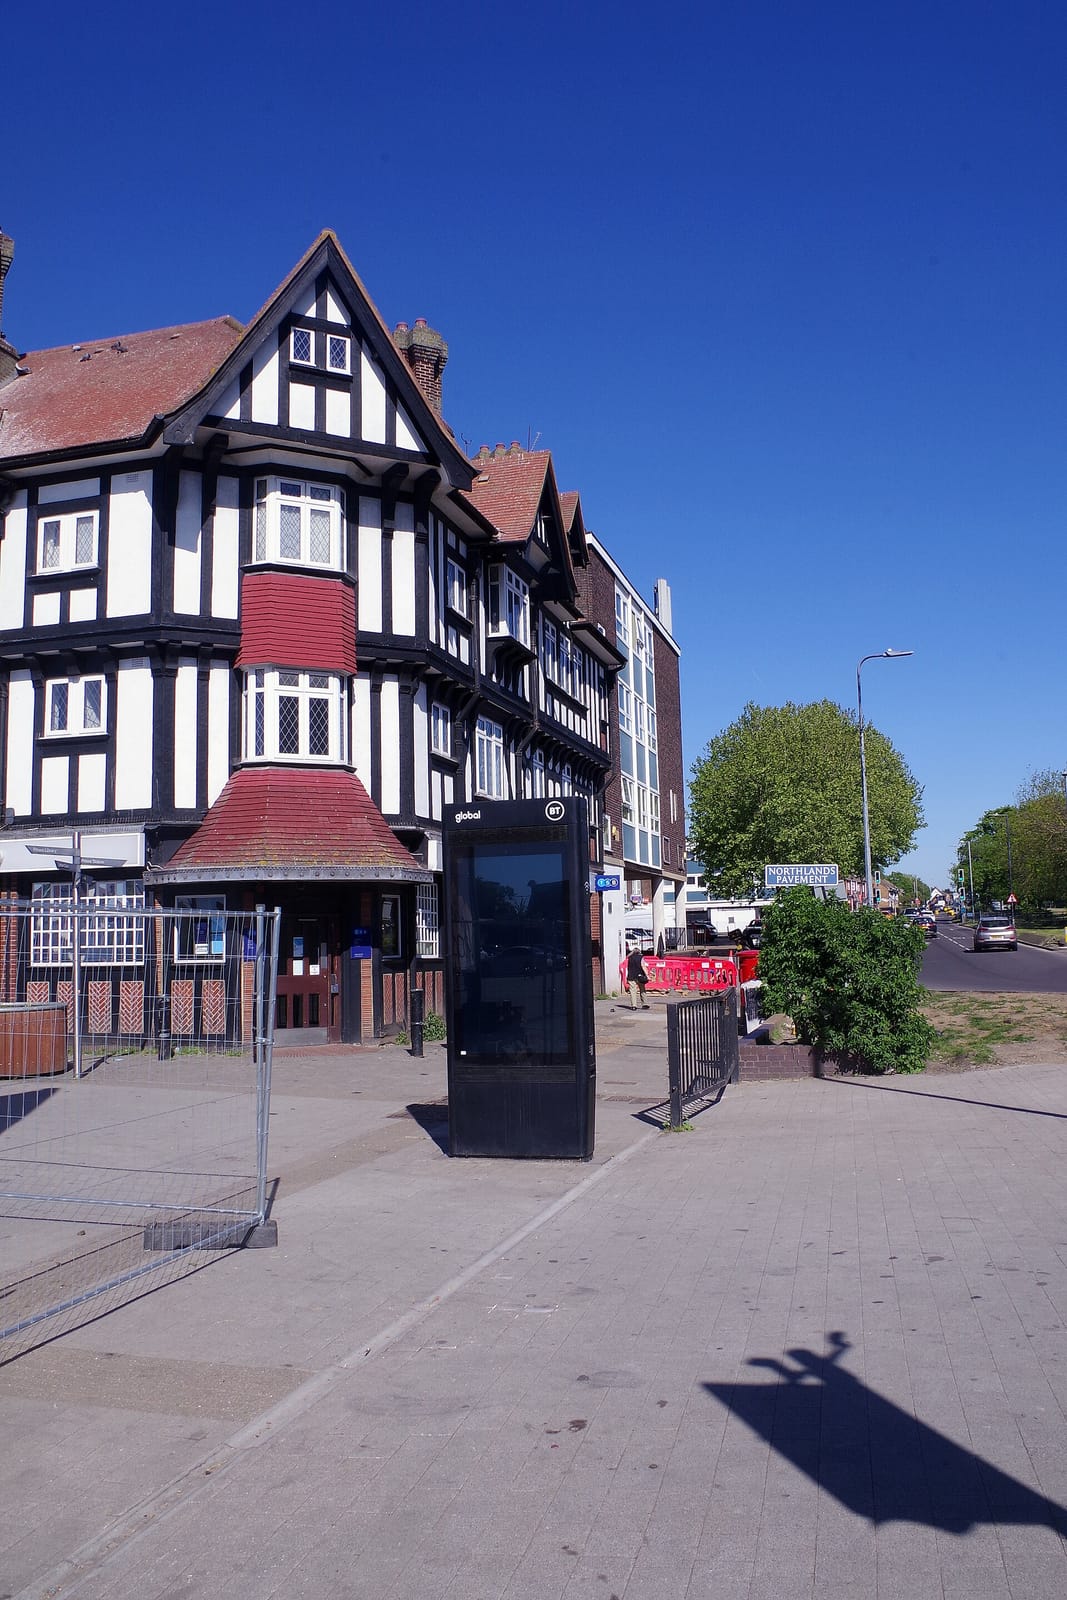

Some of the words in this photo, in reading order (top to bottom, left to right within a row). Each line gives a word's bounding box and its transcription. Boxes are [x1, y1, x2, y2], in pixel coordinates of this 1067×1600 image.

[549, 807, 560, 815] BT
[455, 810, 480, 823] global
[768, 867, 836, 875] NORTHLANDS
[776, 875, 828, 883] PAVEMENT
